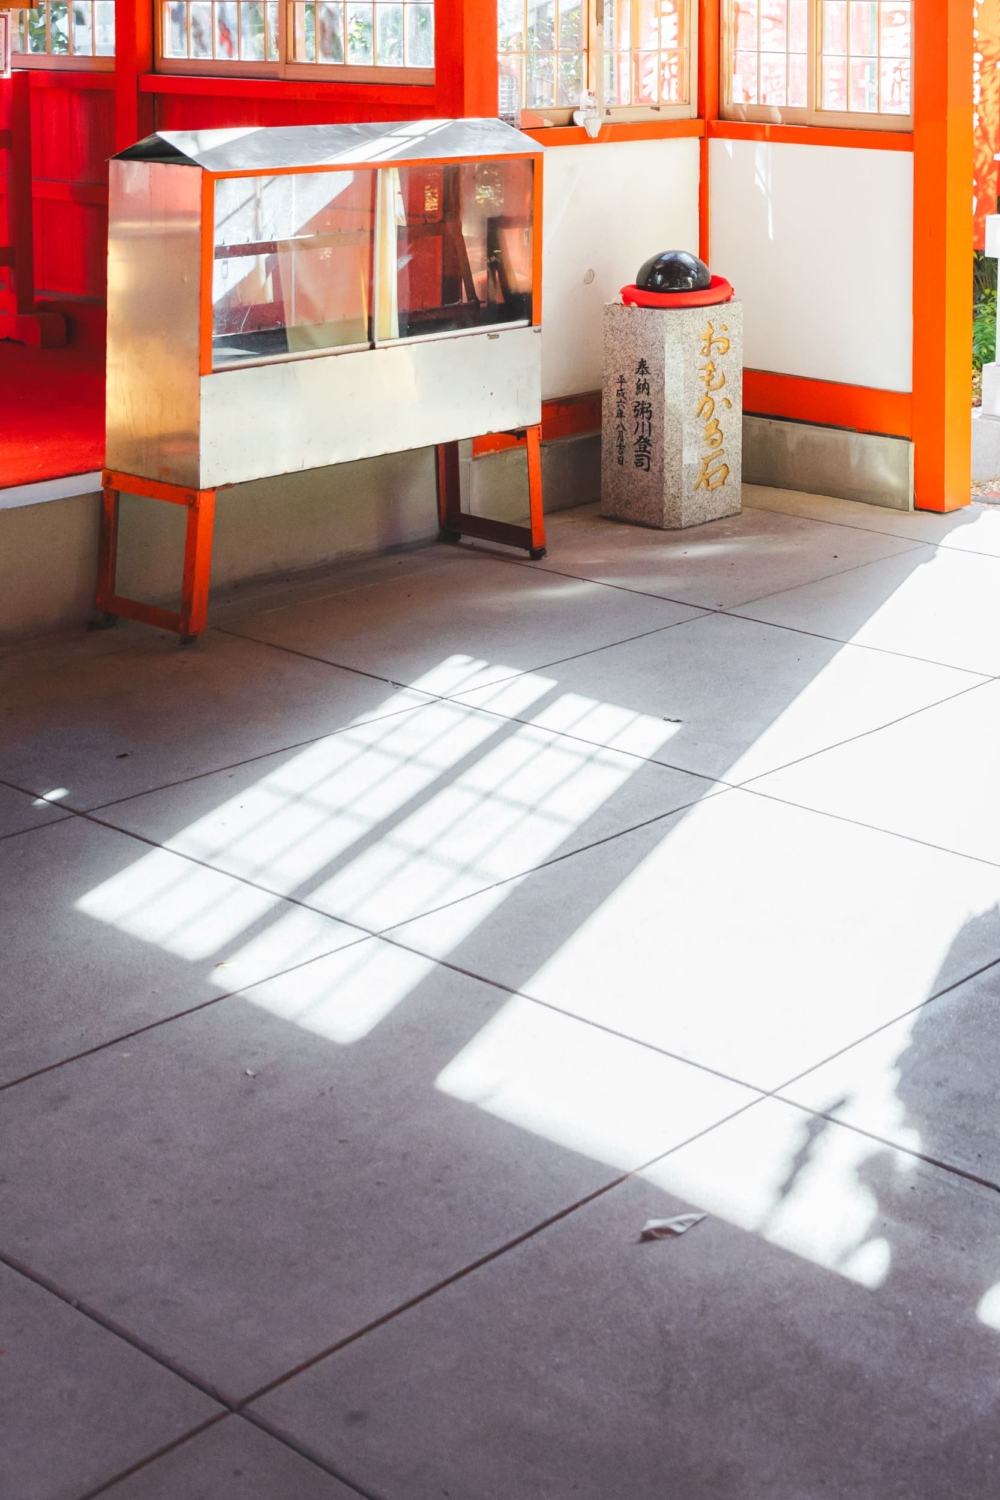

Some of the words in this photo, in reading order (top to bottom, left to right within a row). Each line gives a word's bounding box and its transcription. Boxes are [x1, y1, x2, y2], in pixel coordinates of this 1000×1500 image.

[635, 358, 651, 396] 奉納
[694, 321, 732, 491] おもかる石
